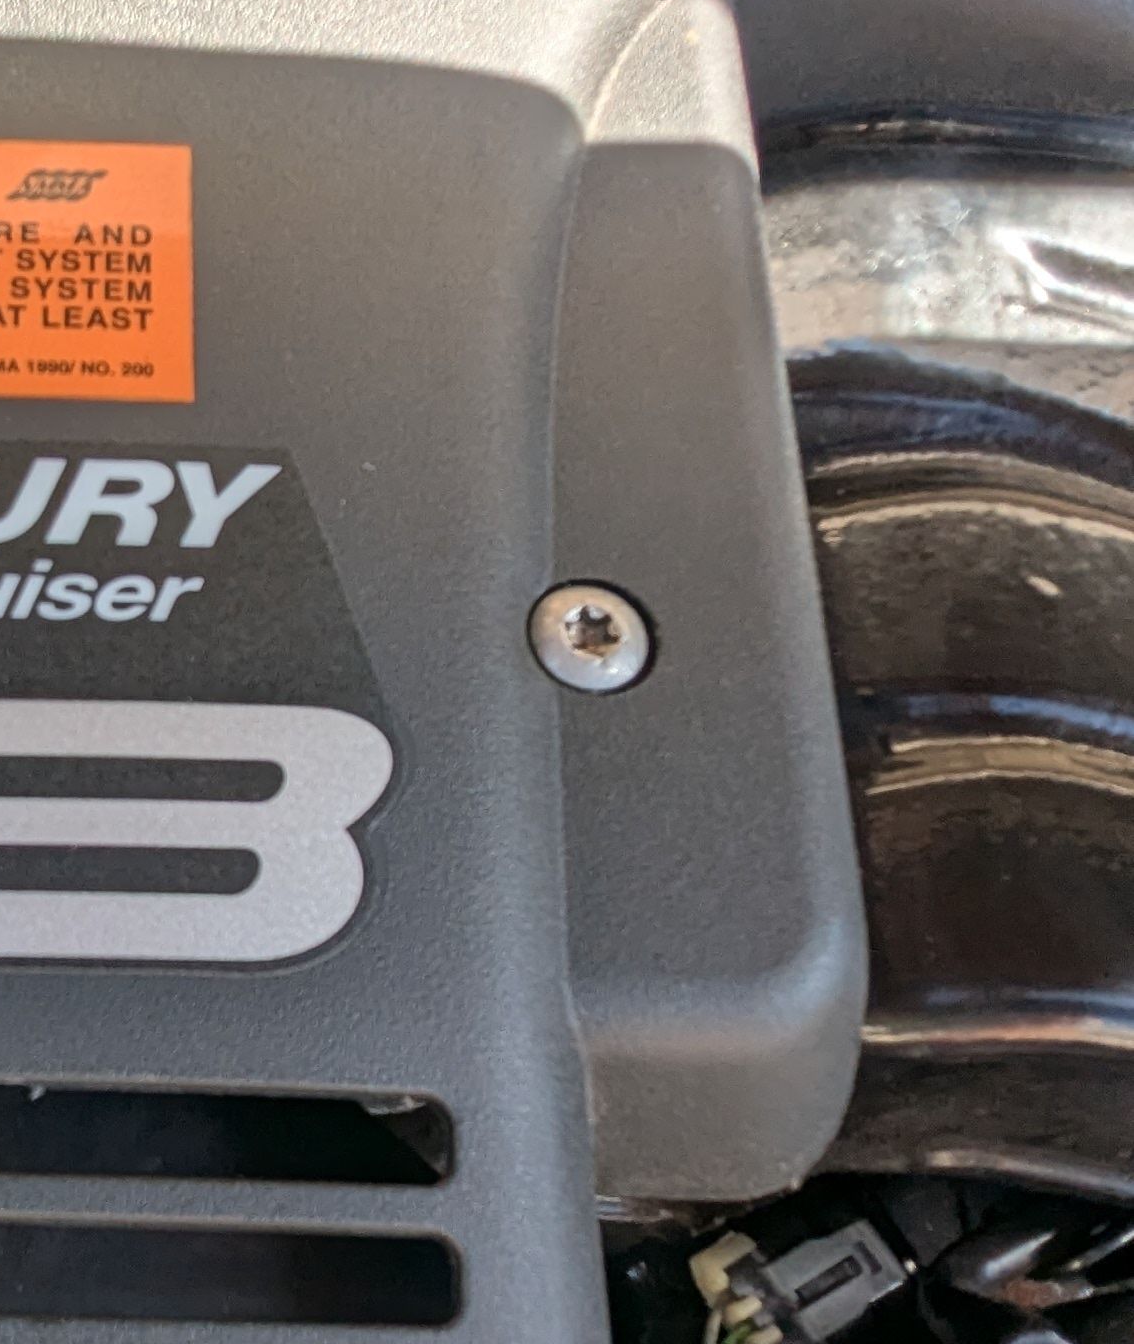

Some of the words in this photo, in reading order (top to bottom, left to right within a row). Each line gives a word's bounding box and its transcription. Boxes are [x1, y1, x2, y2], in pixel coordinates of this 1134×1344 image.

[74, 224, 152, 247] AND
[17, 249, 151, 273] SYSTEM
[11, 276, 152, 302] SYSTEM
[42, 306, 153, 331] LEAST
